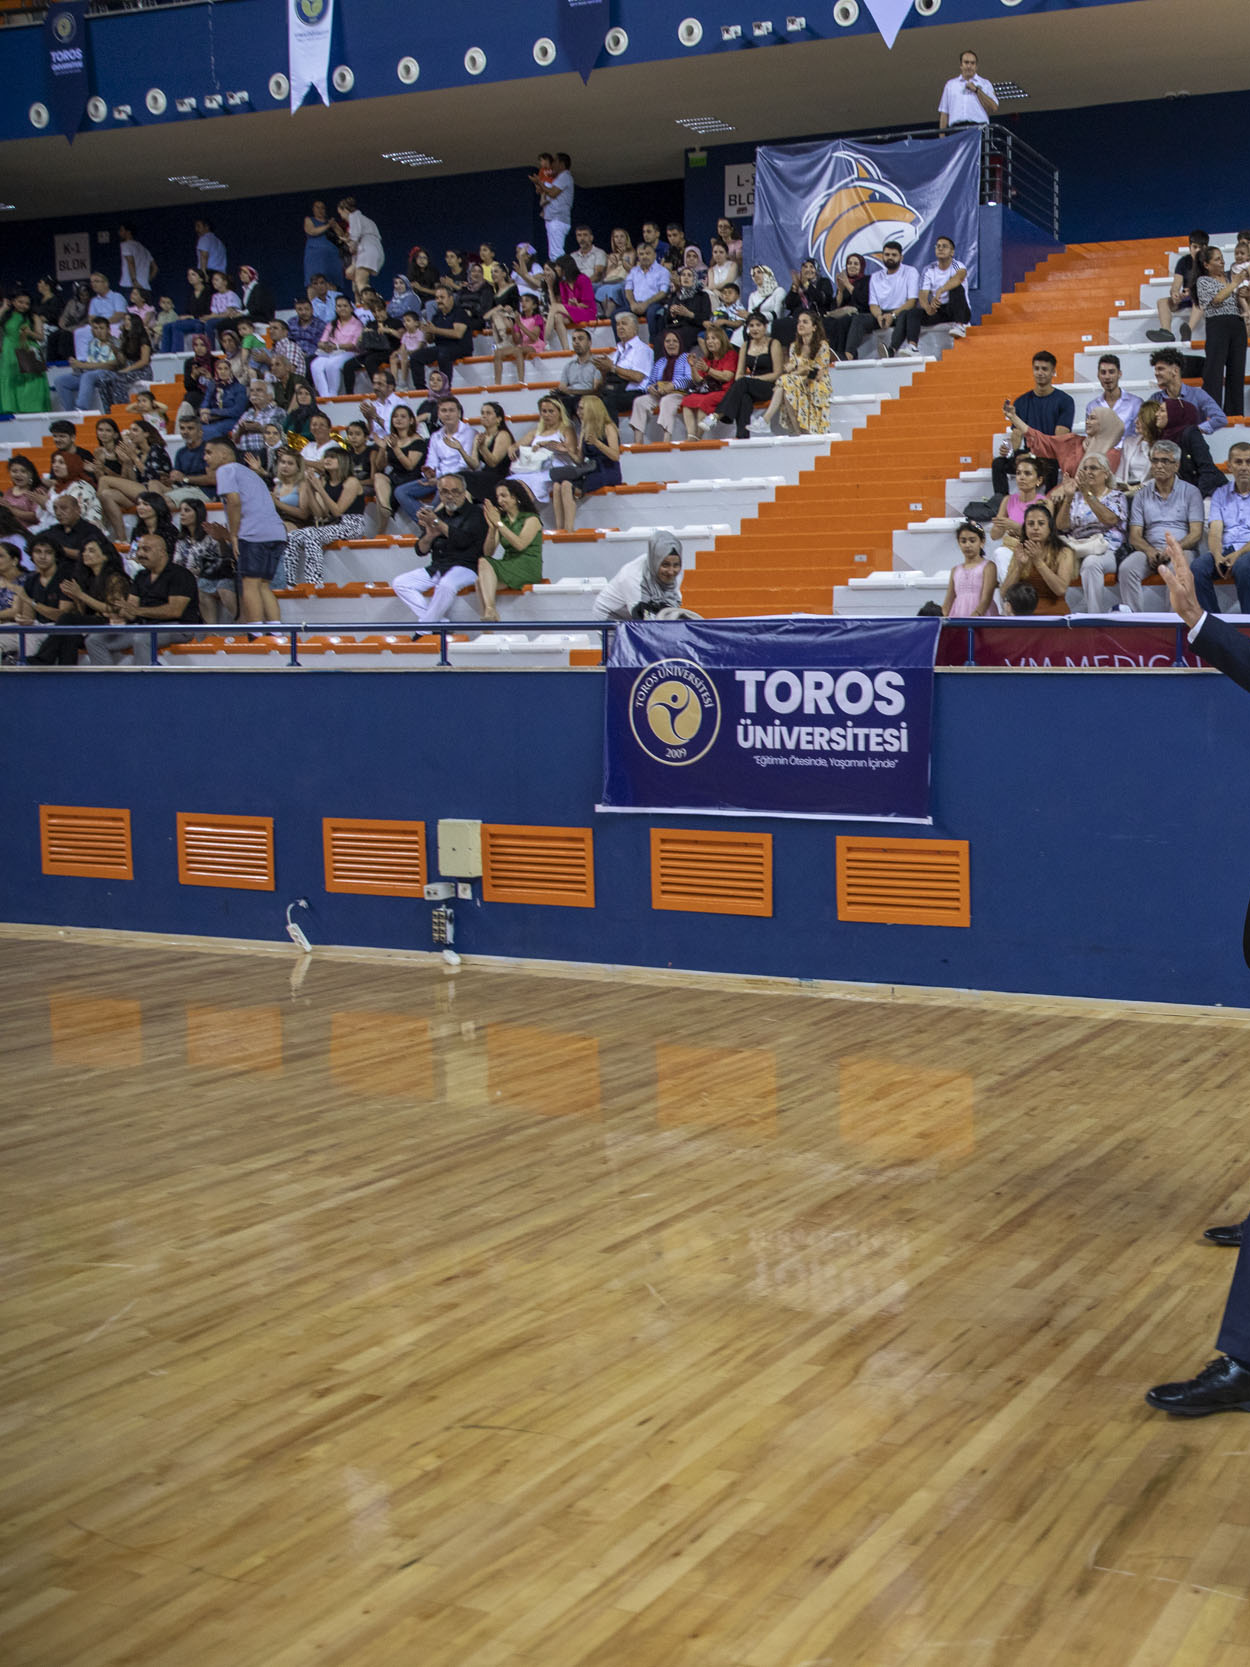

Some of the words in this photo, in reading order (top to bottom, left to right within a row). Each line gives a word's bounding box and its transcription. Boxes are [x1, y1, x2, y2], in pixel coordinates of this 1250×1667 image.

[728, 192, 756, 206] BLO
[58, 259, 88, 271] BLOK
[635, 672, 660, 708] TOROS
[735, 670, 906, 716] TOROS
[736, 718, 909, 753] ÜNİVERSİTESİ
[665, 747, 688, 758] 2009
